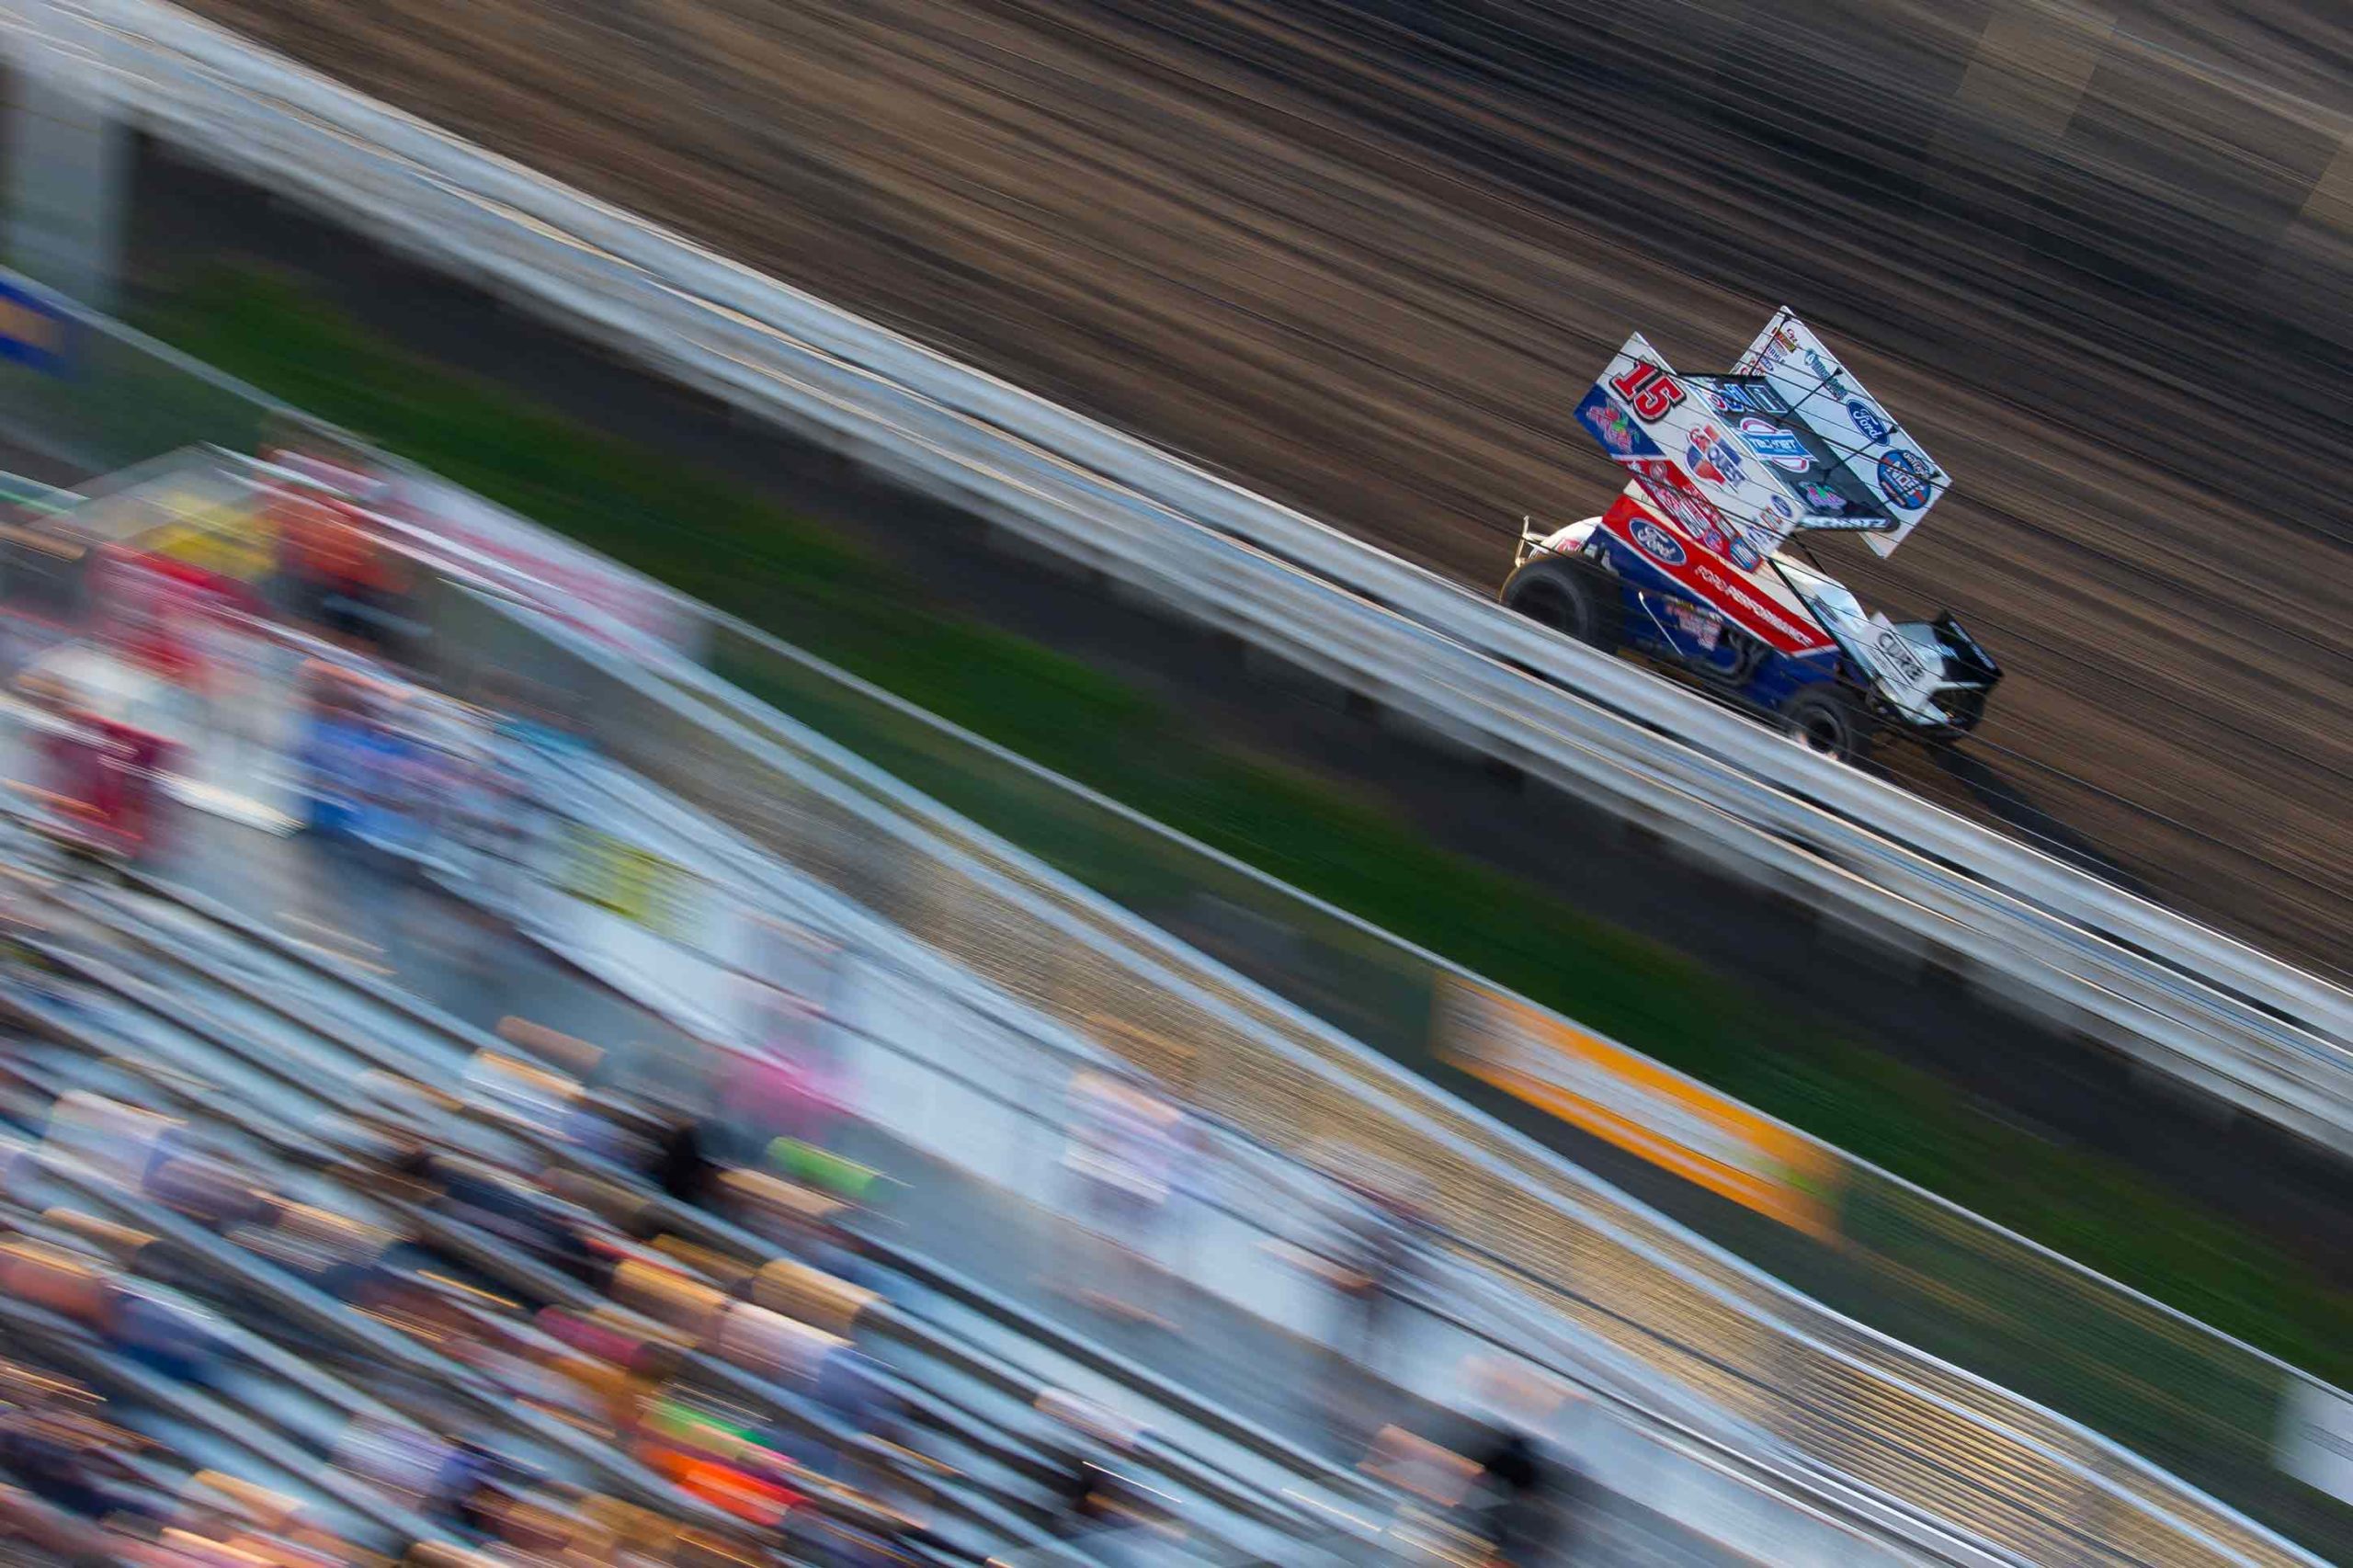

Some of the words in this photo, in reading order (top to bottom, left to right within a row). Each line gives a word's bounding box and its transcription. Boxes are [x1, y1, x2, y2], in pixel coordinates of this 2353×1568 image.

[1609, 356, 1687, 424] 15
[1852, 408, 1882, 439] Ford
[1637, 525, 1677, 560] Ford
